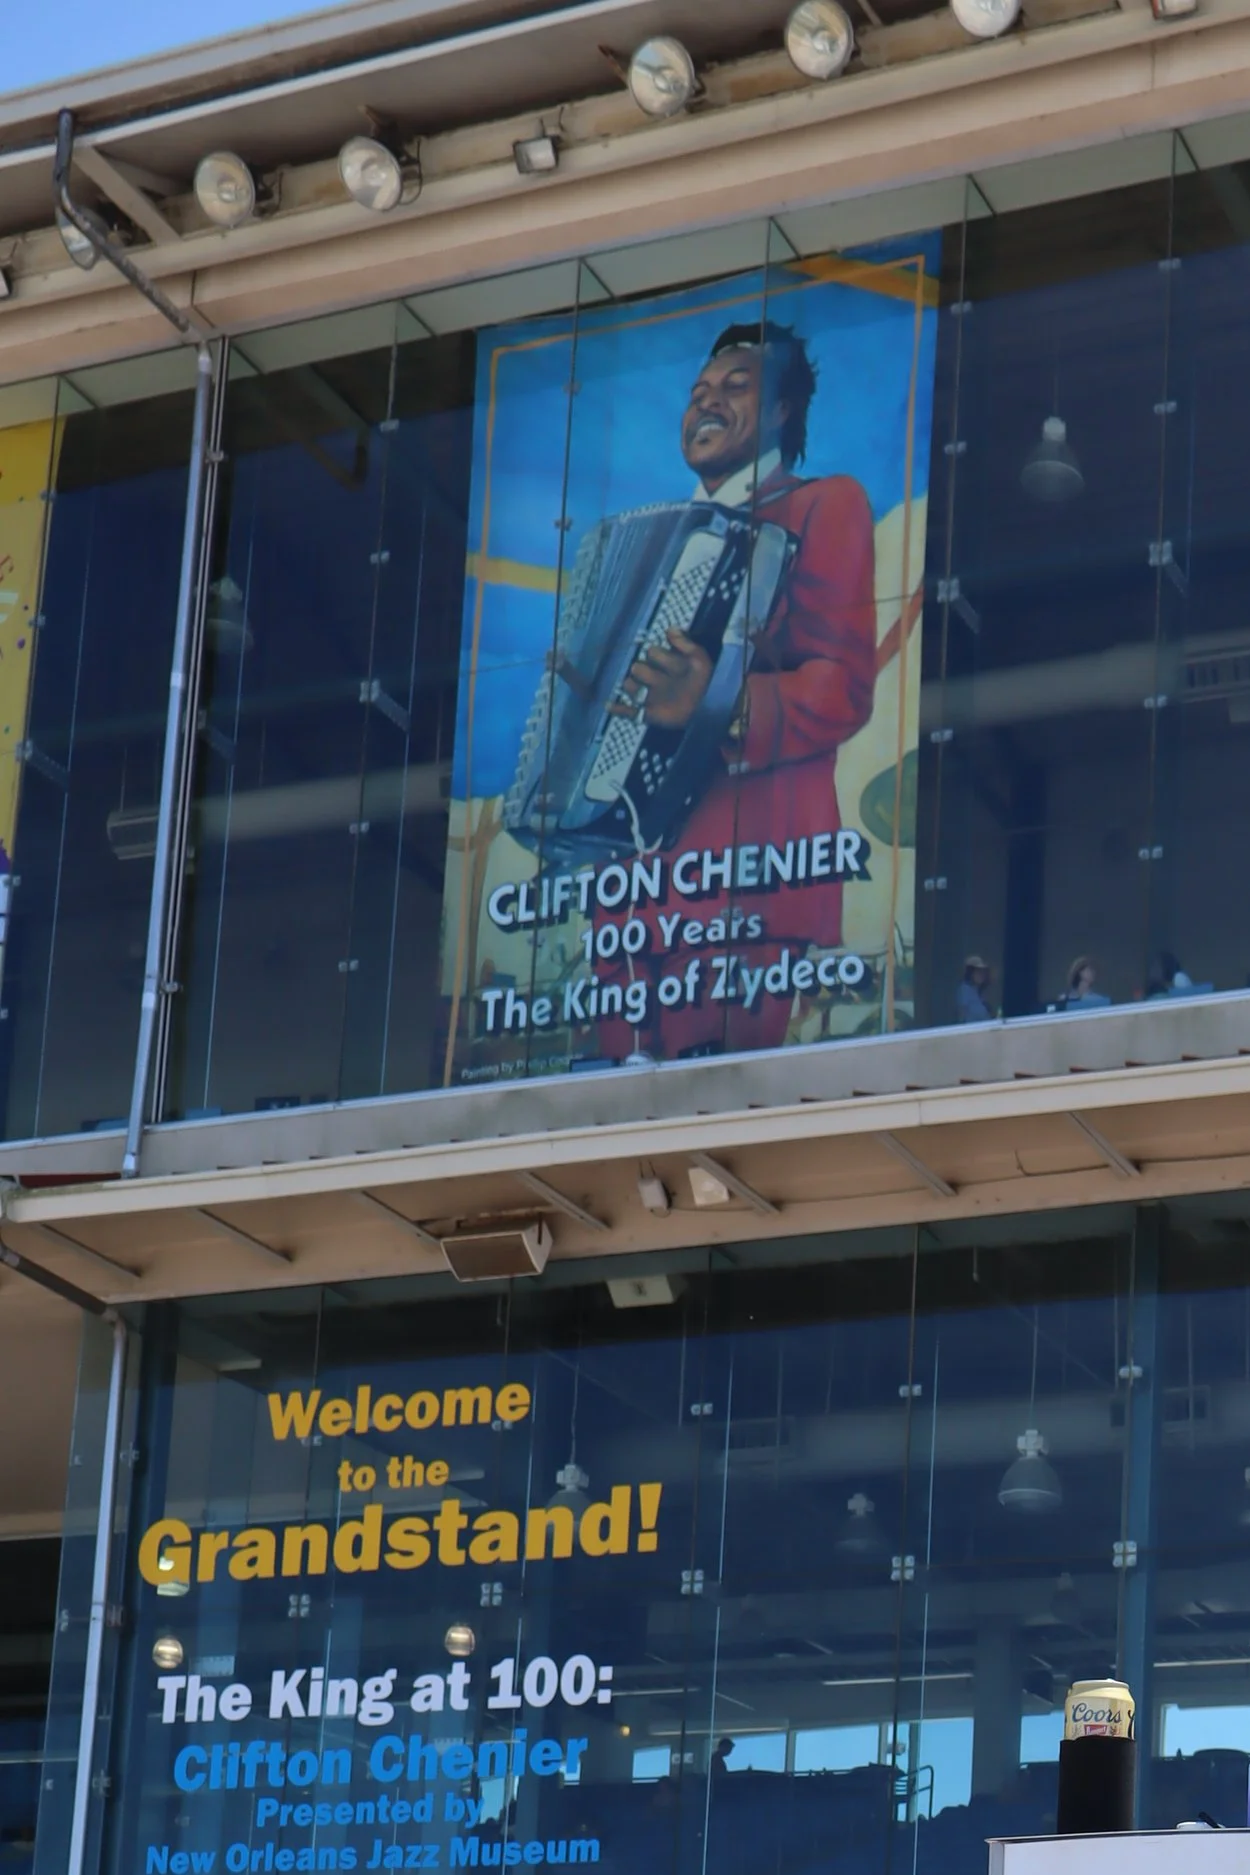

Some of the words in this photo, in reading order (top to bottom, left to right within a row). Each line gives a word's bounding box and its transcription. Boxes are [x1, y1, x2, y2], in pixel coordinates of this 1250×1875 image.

[488, 857, 662, 926] CLIFTON
[673, 829, 863, 896] CHENIER
[582, 917, 646, 961] 100
[658, 911, 763, 948] Years
[482, 988, 551, 1032] The
[564, 976, 647, 1024] King
[658, 957, 700, 1007] of
[711, 948, 865, 1009] Zydeco
[268, 1382, 531, 1441] Welcome
[338, 1461, 376, 1492] to
[386, 1456, 450, 1488] the
[138, 1482, 663, 1587] Grandstand!
[156, 1674, 252, 1724] The
[268, 1667, 397, 1726] King
[410, 1662, 471, 1713] at
[487, 1655, 614, 1709] 100:
[1071, 1702, 1122, 1723] Coors
[174, 1739, 352, 1791] Clifton
[370, 1728, 589, 1783] Chenier
[256, 1793, 434, 1827] Presented
[444, 1793, 485, 1829] by
[146, 1846, 216, 1875] New
[226, 1842, 357, 1873] Orleans
[366, 1838, 440, 1869] Jazz
[450, 1836, 600, 1868] Museum
